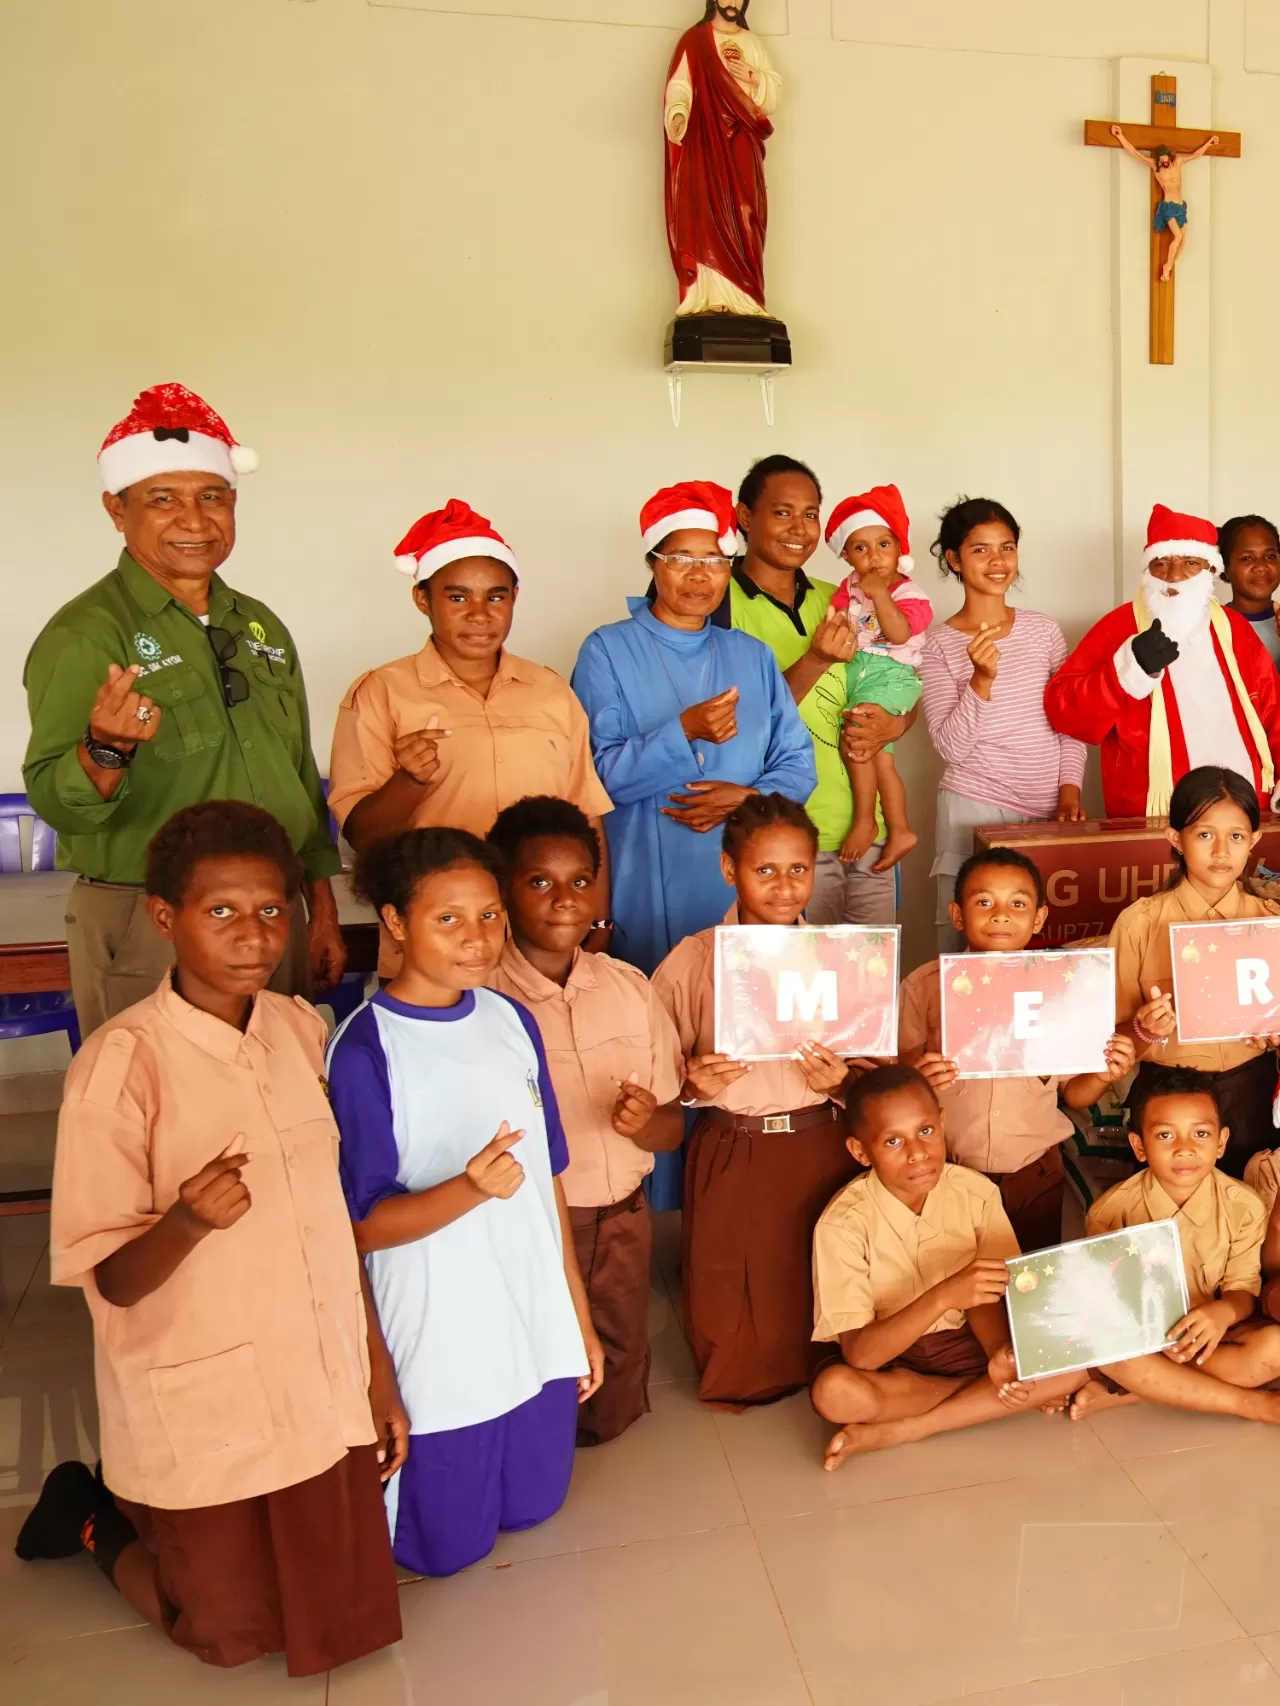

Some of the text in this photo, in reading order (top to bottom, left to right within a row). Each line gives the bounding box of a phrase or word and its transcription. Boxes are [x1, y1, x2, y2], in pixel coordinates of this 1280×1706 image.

[776, 969, 839, 1022] M
[1235, 957, 1274, 1006] R
[1013, 990, 1044, 1040] E
